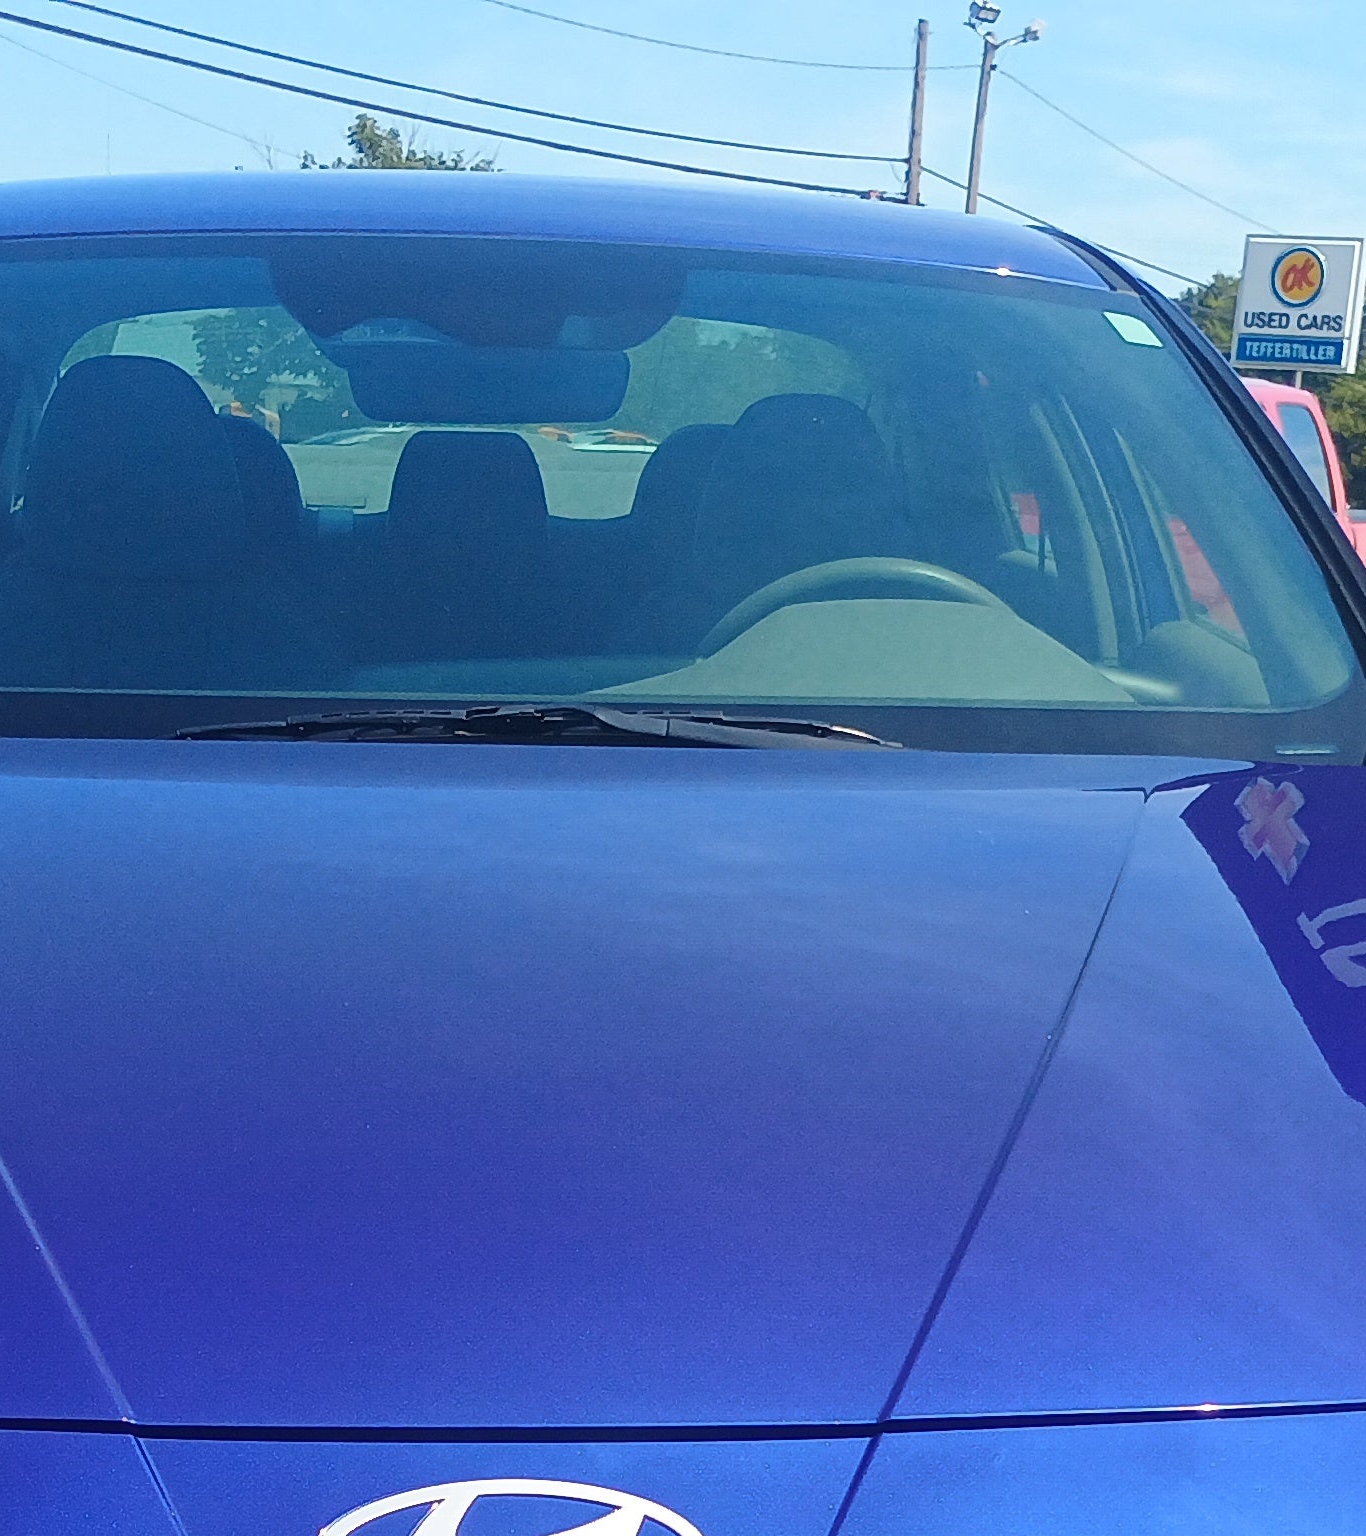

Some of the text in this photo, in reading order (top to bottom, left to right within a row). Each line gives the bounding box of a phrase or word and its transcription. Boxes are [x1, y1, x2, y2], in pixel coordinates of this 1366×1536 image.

[1280, 256, 1315, 294] OK
[1243, 311, 1344, 333] USED CARS
[1245, 341, 1336, 361] TEFFERTILLER
